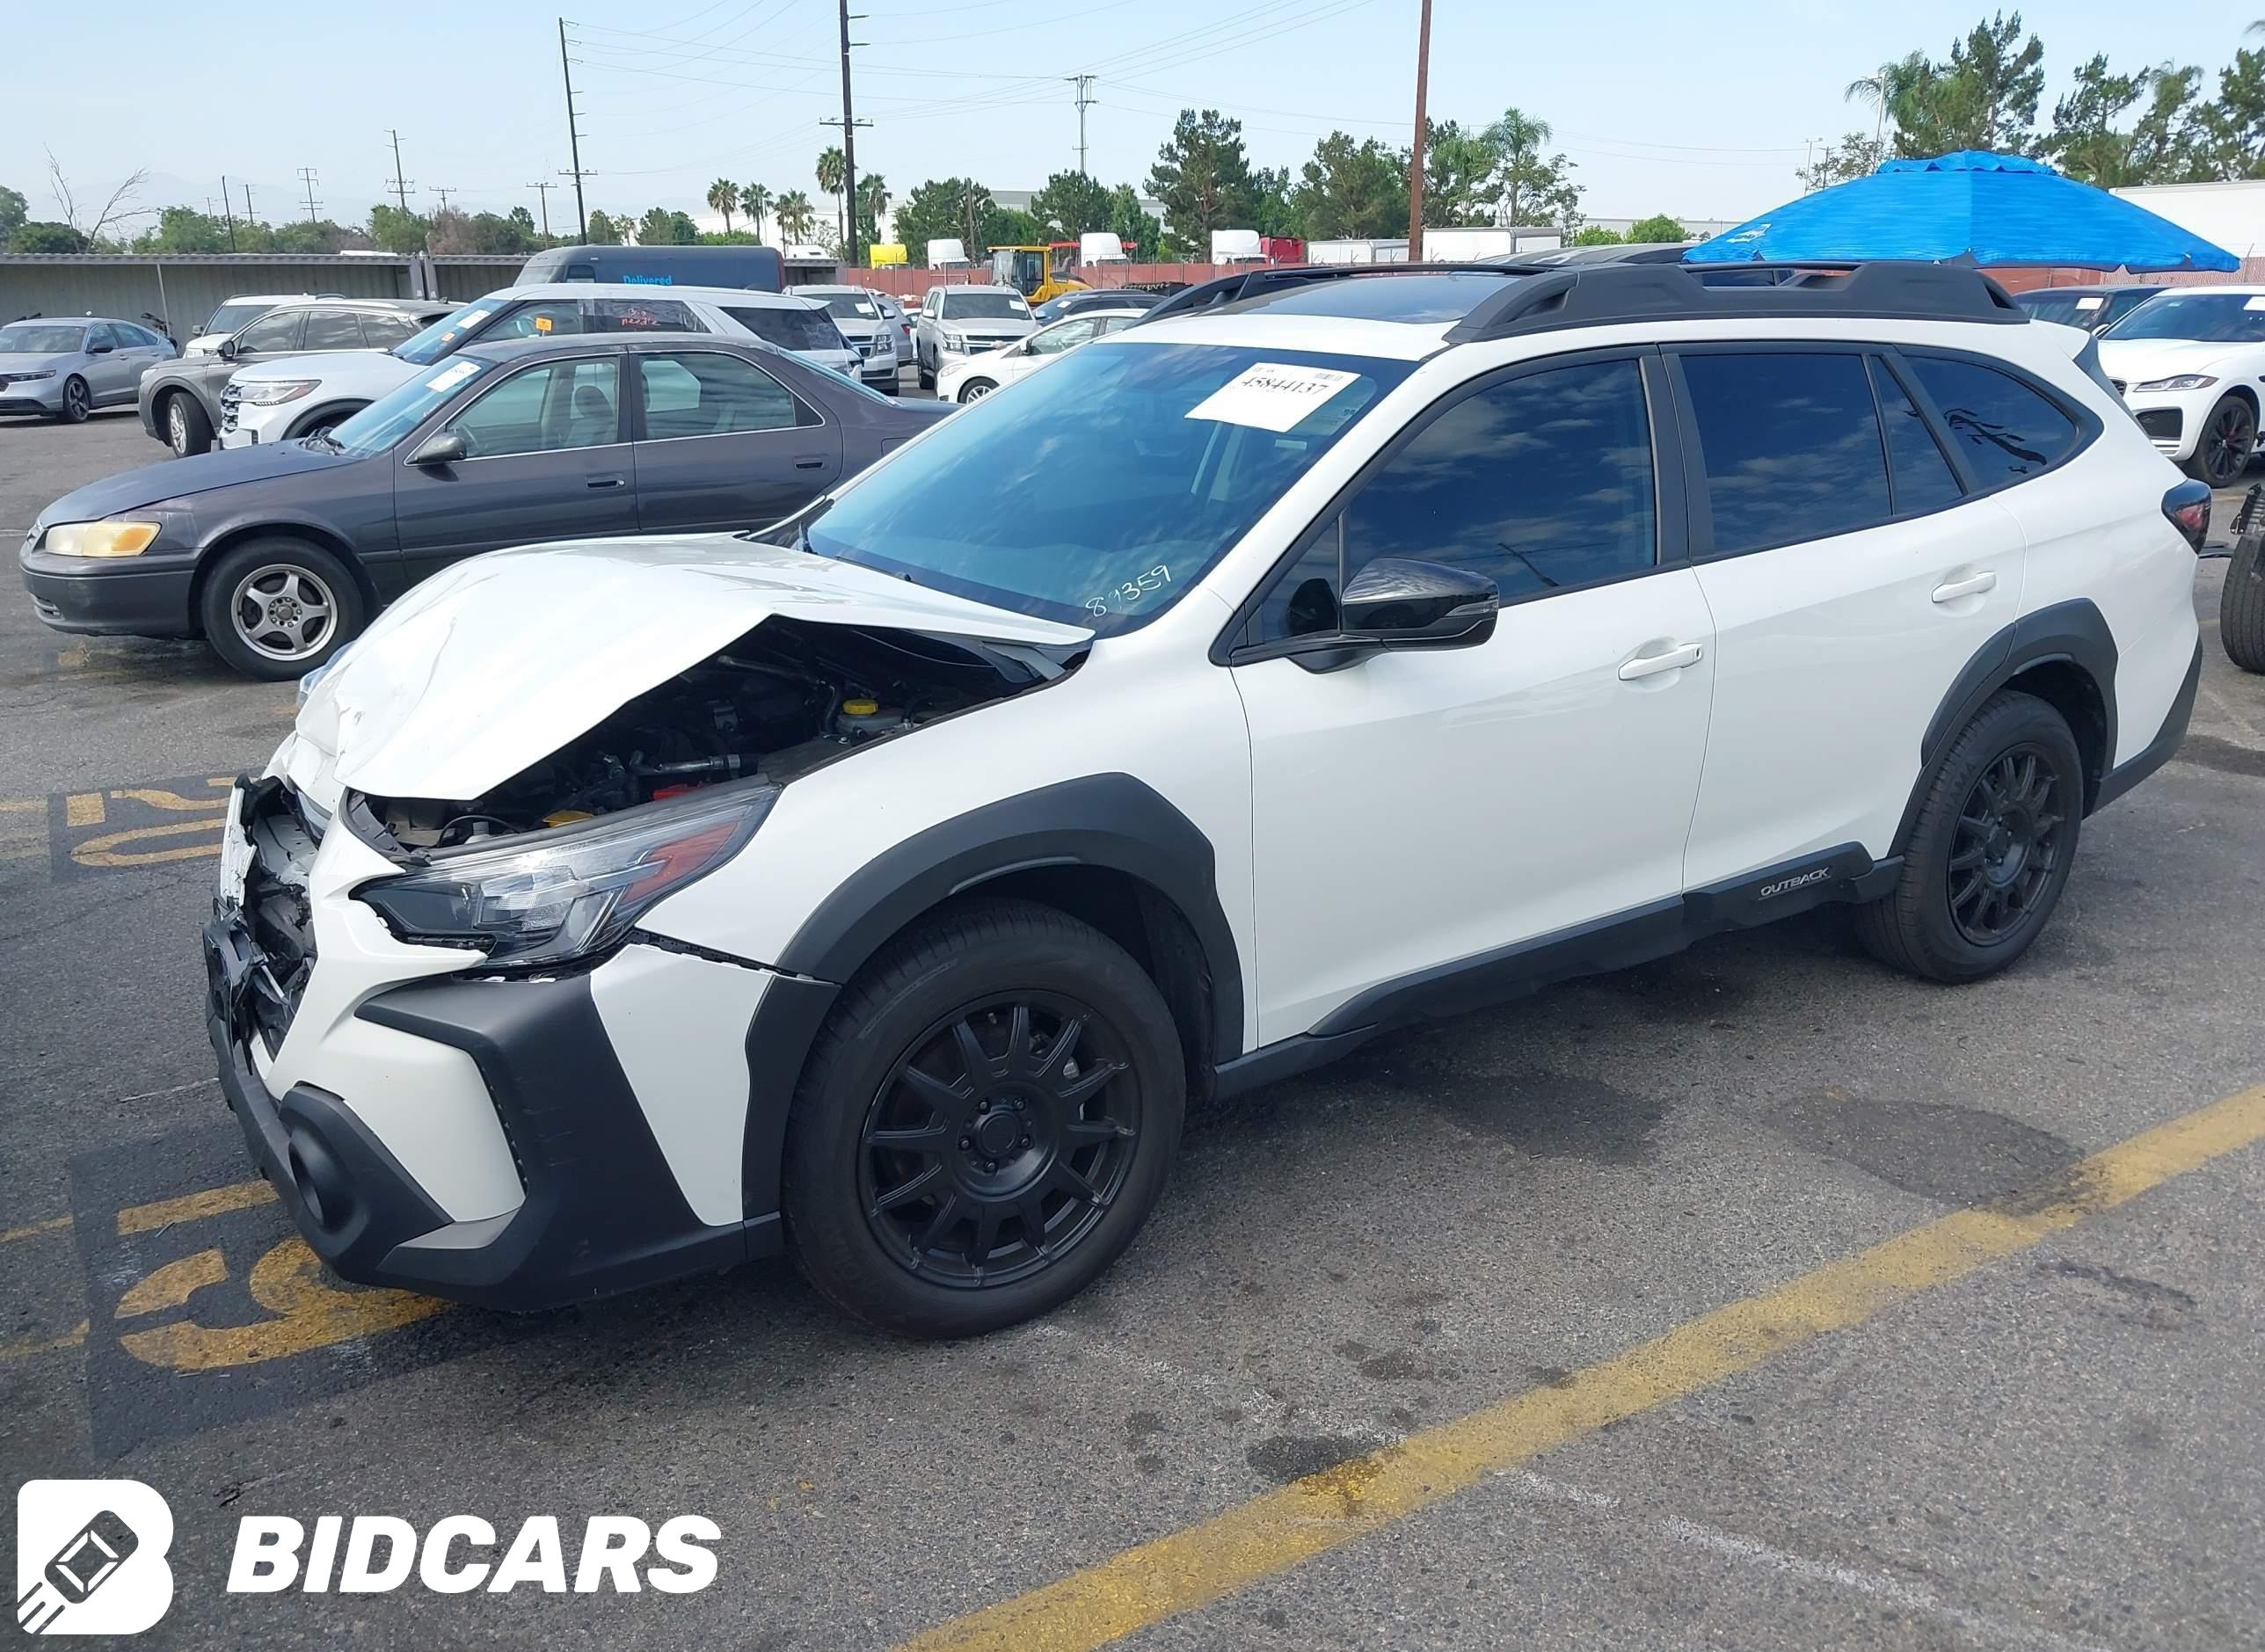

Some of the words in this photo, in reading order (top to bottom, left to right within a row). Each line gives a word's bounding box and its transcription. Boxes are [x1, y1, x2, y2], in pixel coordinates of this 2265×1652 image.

[623, 274, 672, 285] Delivered
[1242, 375, 1329, 395] 45844137
[1760, 867, 1829, 896] OUTBACK
